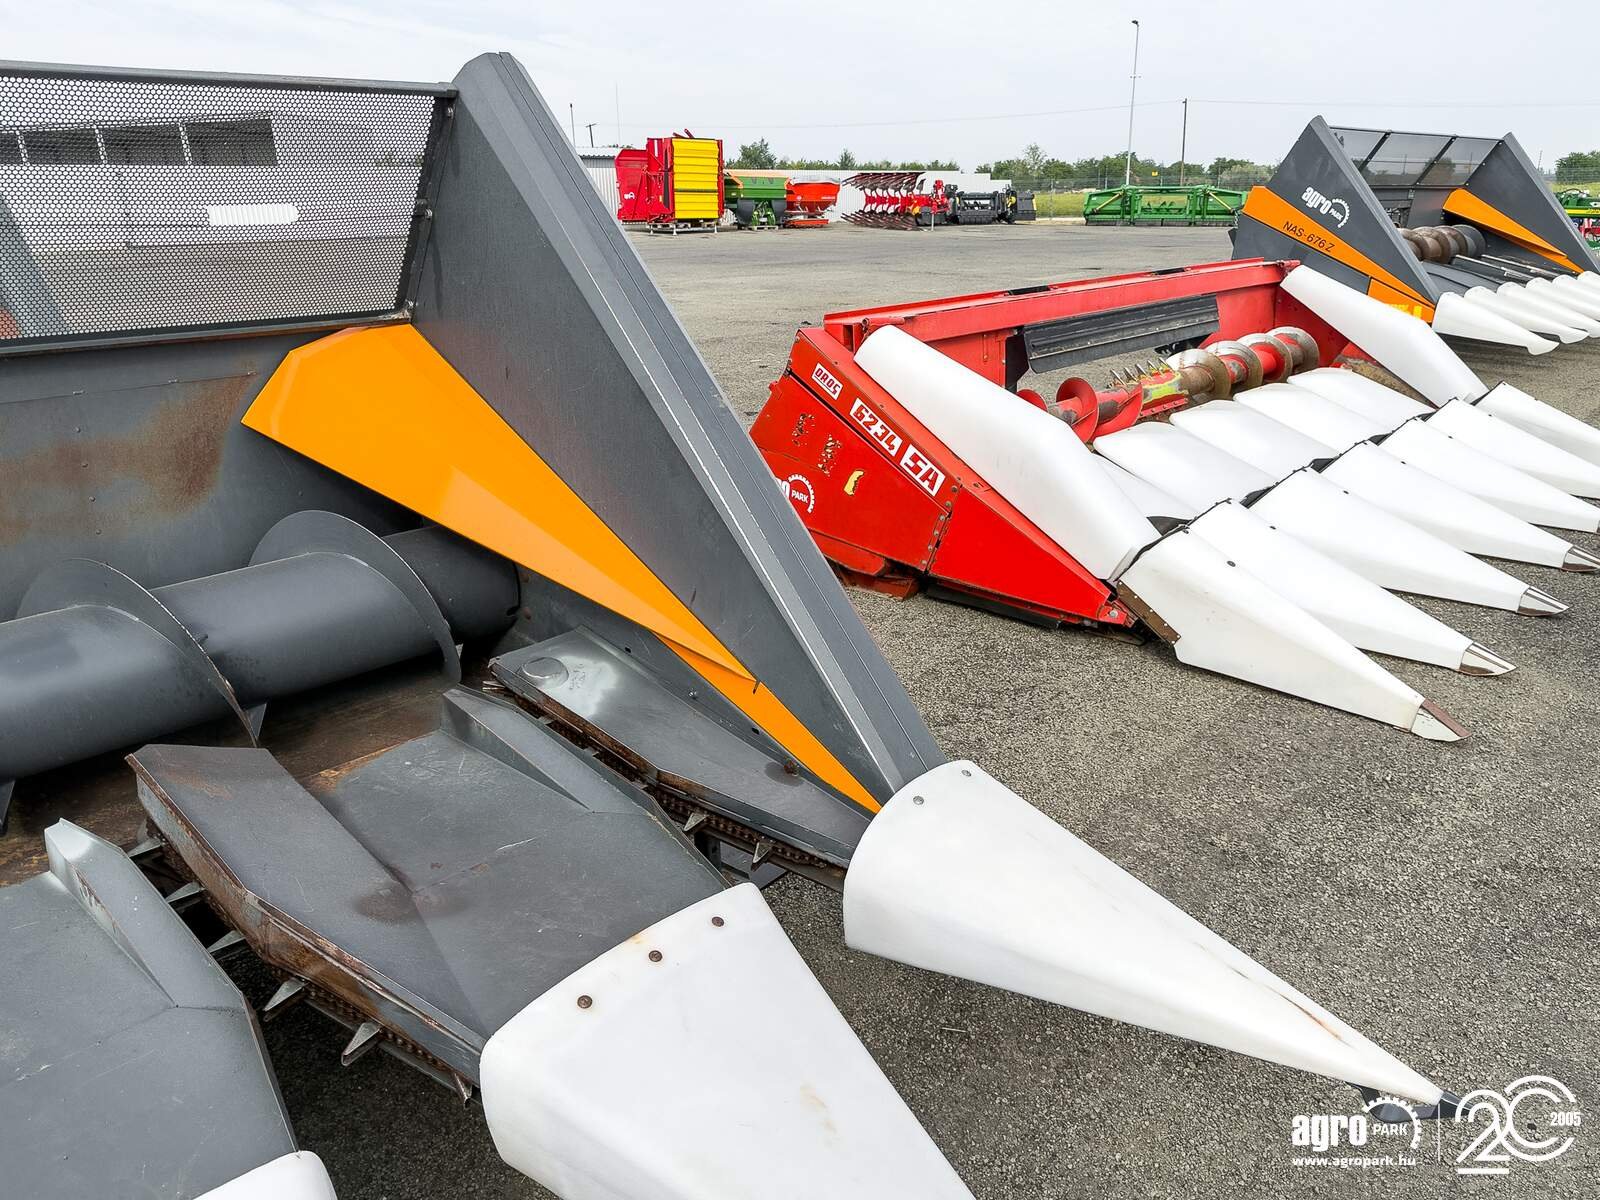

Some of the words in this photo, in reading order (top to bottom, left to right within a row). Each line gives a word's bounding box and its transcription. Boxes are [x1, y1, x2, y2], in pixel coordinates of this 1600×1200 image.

[1301, 186, 1332, 215] agro
[903, 452, 940, 492] SA
[791, 489, 809, 504] PARK
